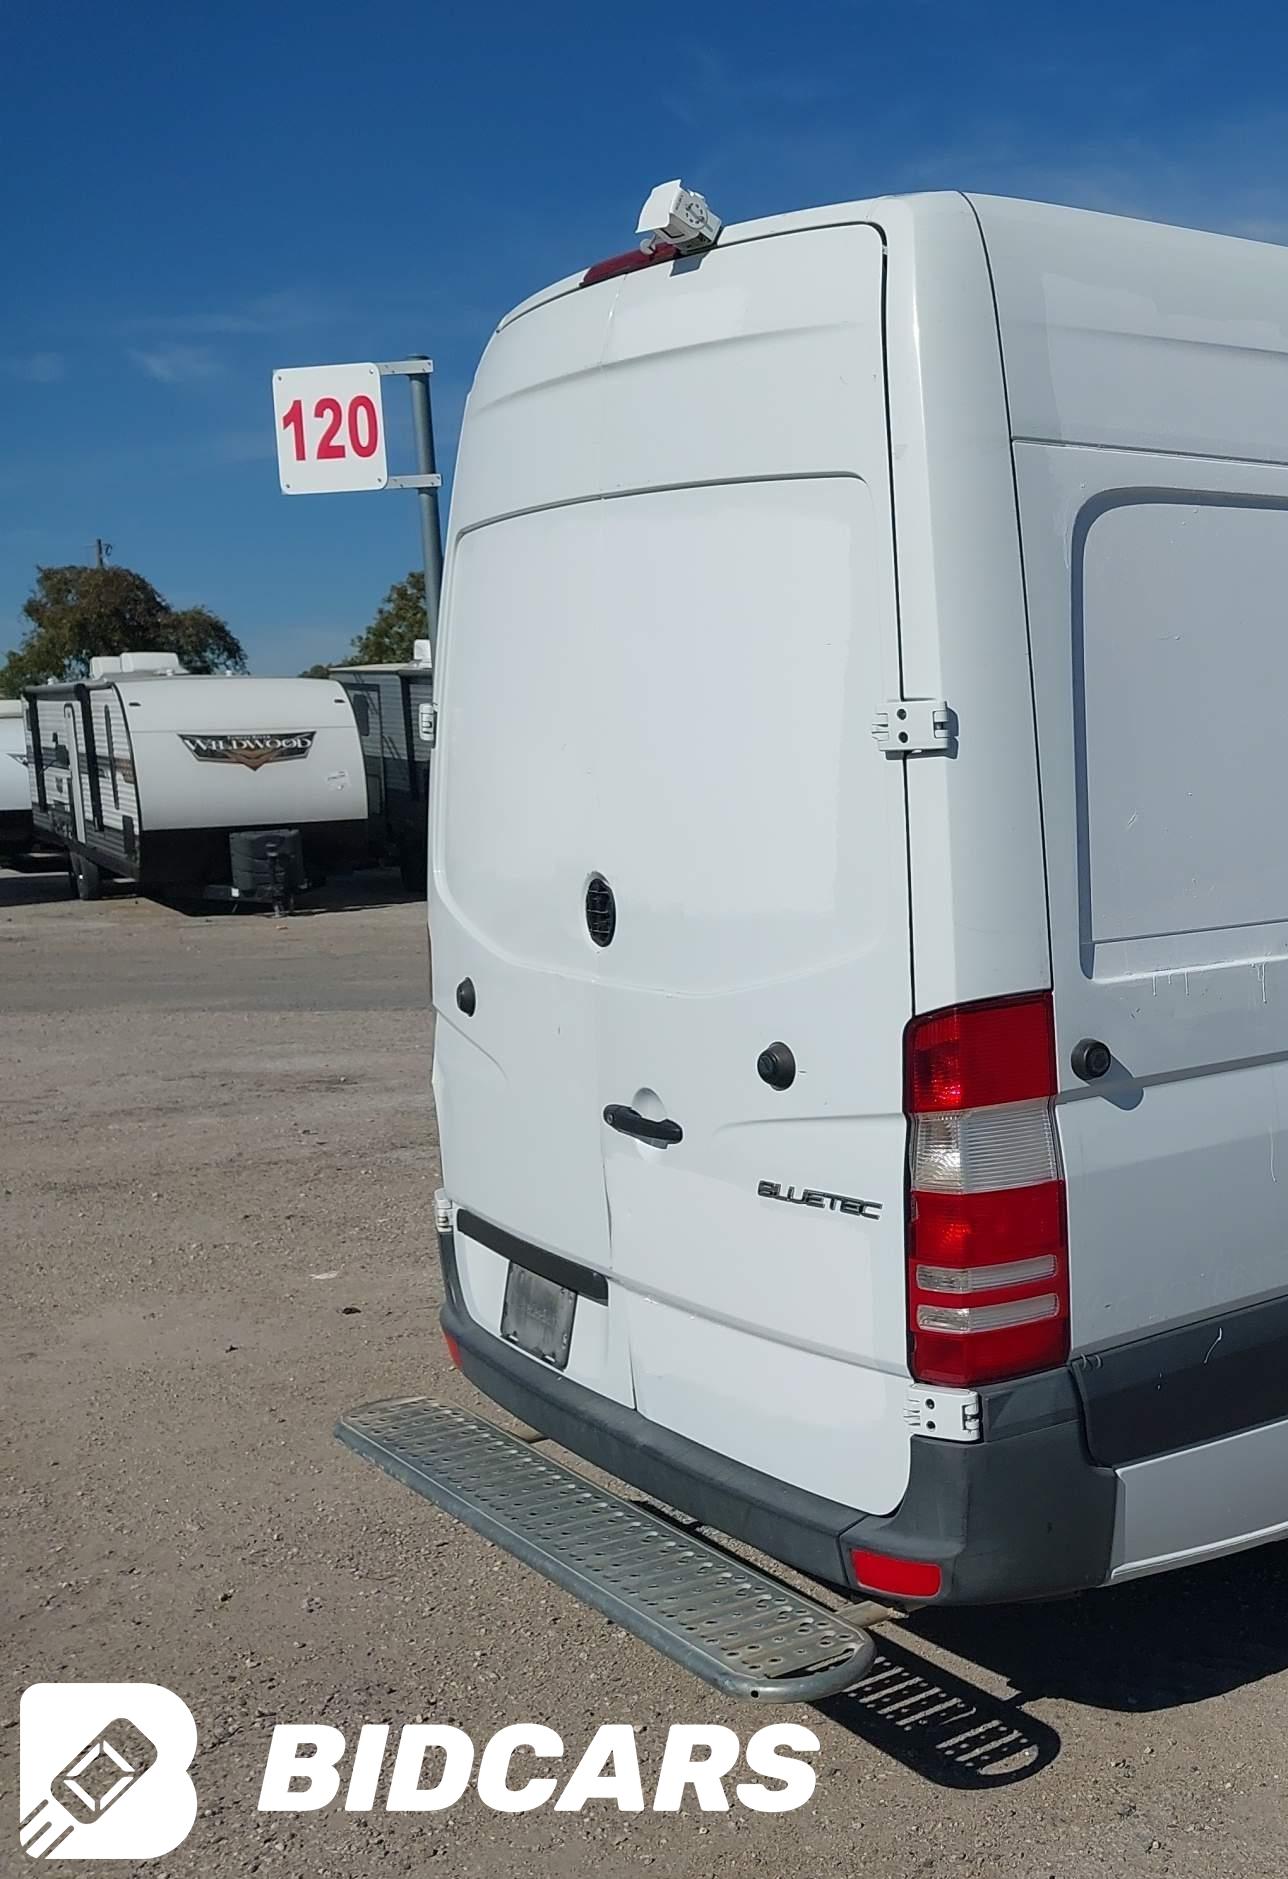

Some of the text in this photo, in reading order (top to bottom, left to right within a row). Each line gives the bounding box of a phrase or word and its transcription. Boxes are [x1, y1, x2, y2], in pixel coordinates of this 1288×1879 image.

[282, 394, 379, 461] 120
[183, 738, 313, 751] WILDWOOD
[757, 1179, 883, 1221] BLUETEC
